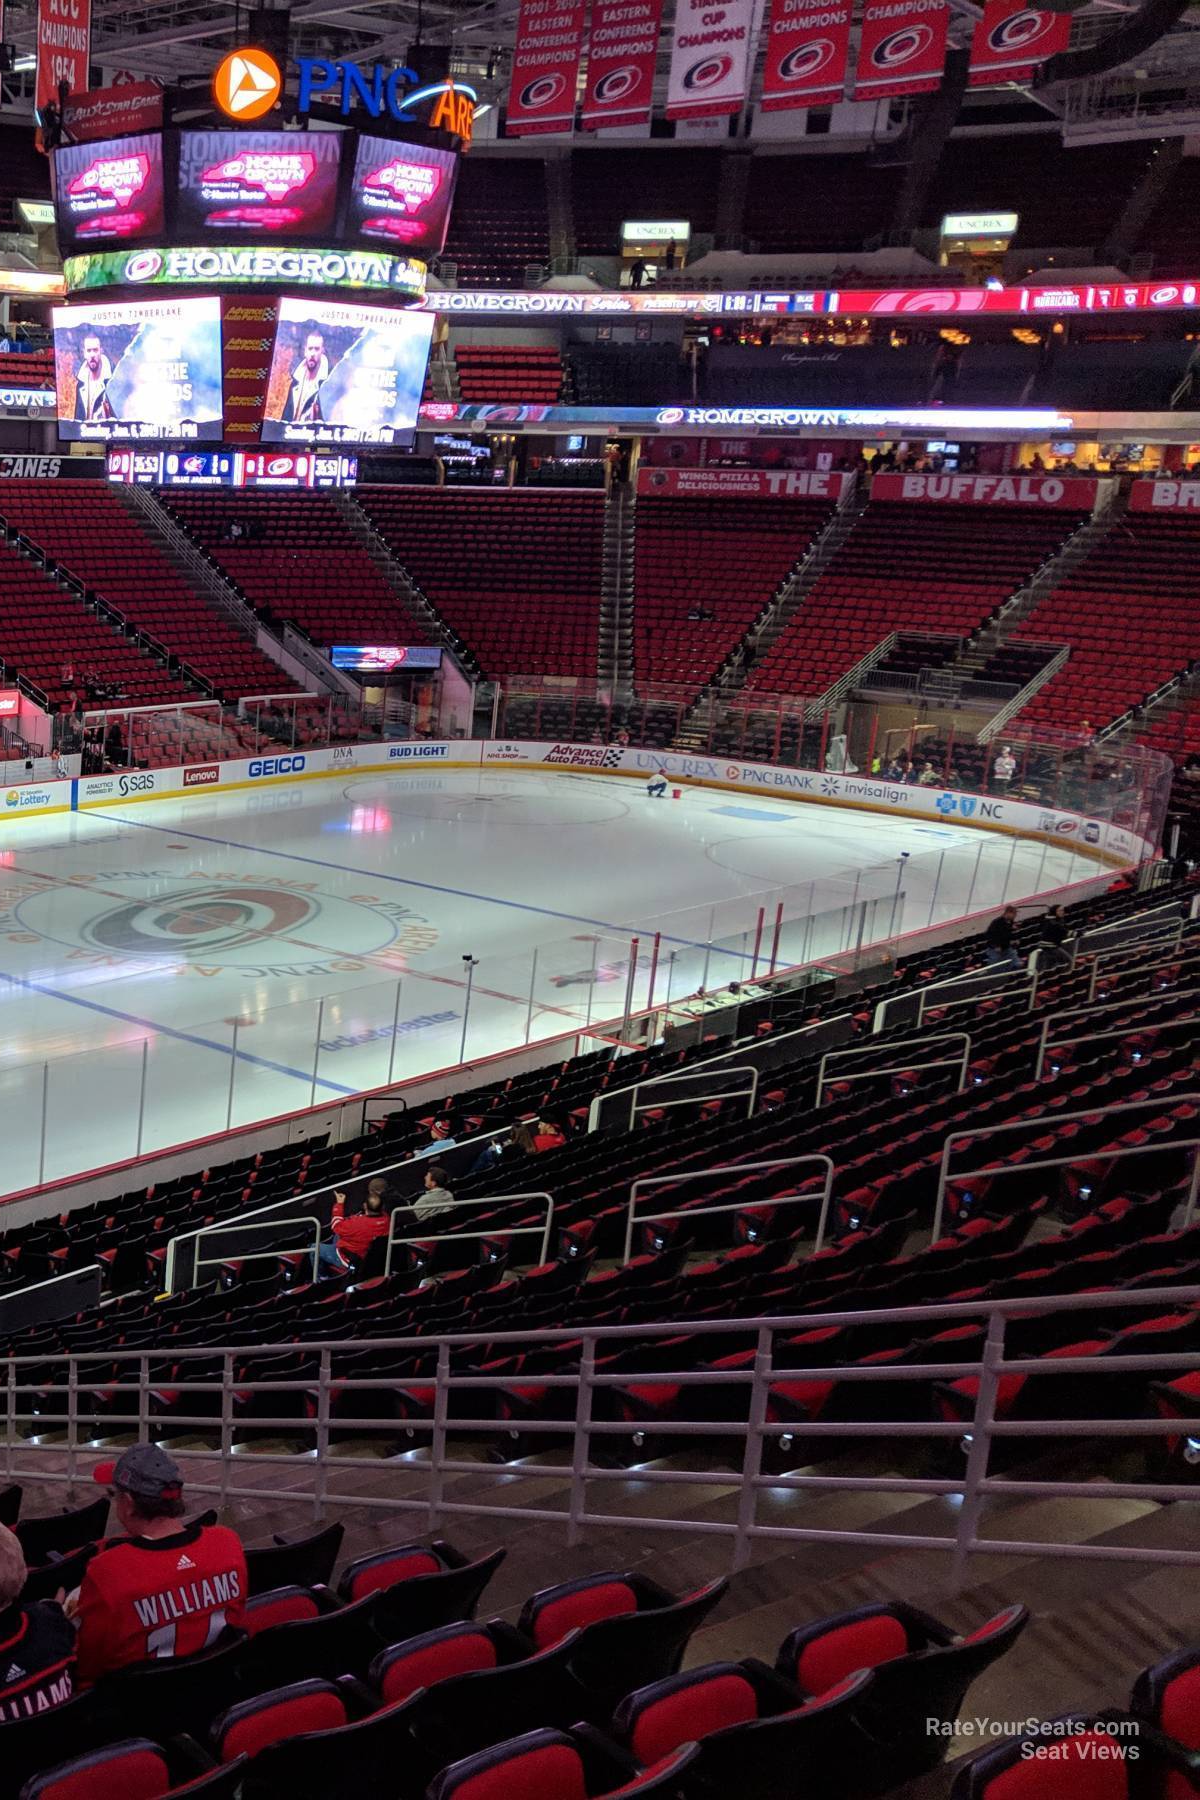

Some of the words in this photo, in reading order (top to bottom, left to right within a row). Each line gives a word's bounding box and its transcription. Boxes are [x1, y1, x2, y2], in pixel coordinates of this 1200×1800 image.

[602, 5, 651, 23] EASTERN
[701, 11, 726, 26] CUP
[773, 10, 848, 34] CHAMPIONS
[528, 16, 572, 32] EASTERN
[592, 22, 657, 42] CONFERENCE
[41, 20, 87, 52] CHAMPIONS
[519, 32, 579, 49] CONFERENCE
[677, 26, 746, 49] CHAMPIONS
[516, 50, 577, 68] CHAMPIONS
[591, 40, 655, 60] CHAMPIONS
[295, 56, 420, 123] PNC
[167, 251, 393, 283] HOMEGROWN
[432, 294, 585, 312] HOMEGROWN
[1033, 294, 1080, 308] HURRICANES
[93, 310, 123, 321] JUSTIN
[127, 306, 183, 320] TIMBERLAKE
[687, 408, 840, 425] HOMEGROWN
[0, 458, 62, 479] CANES
[678, 472, 718, 482] WINGS,
[719, 473, 750, 482] PIZZA
[751, 473, 760, 482] &
[677, 481, 761, 491] DELICIOUSNESS
[764, 472, 831, 495] THE
[901, 475, 1065, 503] BUFFALO
[389, 747, 412, 757] BUD
[412, 746, 447, 756] LIGHT
[550, 744, 601, 758] Advance
[248, 755, 306, 778] GEICO
[542, 754, 566, 764] Auto
[567, 756, 601, 767] Parts
[636, 753, 677, 772] UNC
[681, 760, 719, 777] REX
[86, 781, 114, 790] ANALYTICS
[129, 773, 155, 790] sas
[184, 770, 217, 783] Lenovo
[20, 794, 51, 806] Lottery
[844, 780, 908, 803] invisalign
[980, 801, 1005, 820] NC
[185, 869, 319, 893] ARENA
[315, 1008, 463, 1053] ticketmaster
[133, 1570, 241, 1628] WILLIAMS
